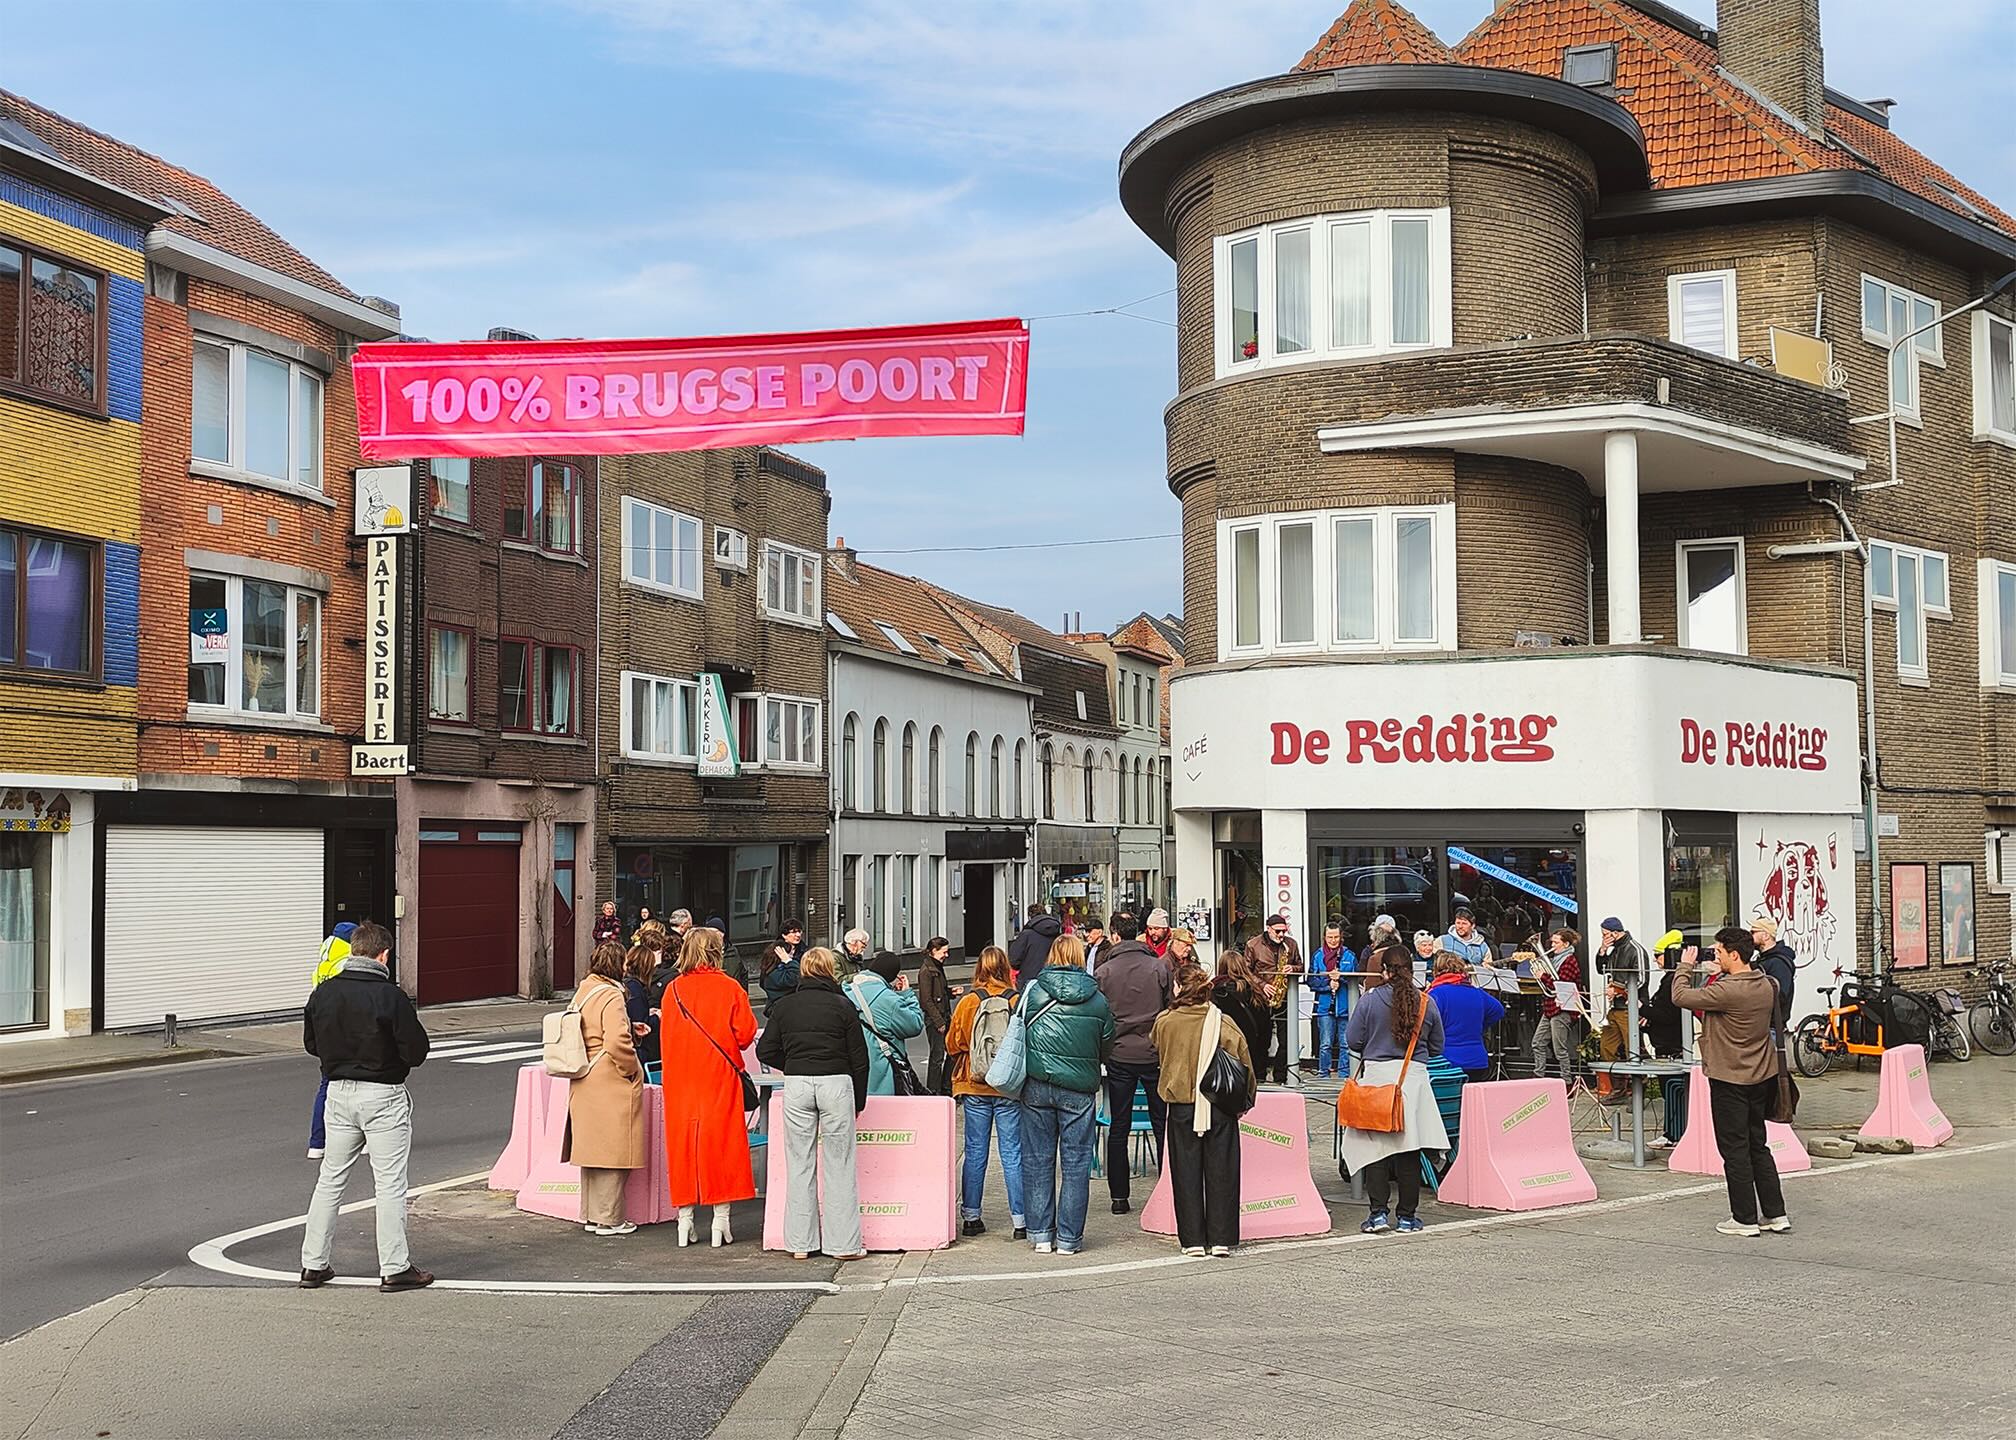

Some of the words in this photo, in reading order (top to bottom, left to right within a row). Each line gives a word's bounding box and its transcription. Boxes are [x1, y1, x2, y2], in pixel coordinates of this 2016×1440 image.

[401, 375, 551, 423] 100%
[565, 365, 787, 420] BRUGSE
[801, 355, 989, 407] POORT
[373, 540, 390, 740] PATISSERIE
[702, 676, 711, 755] BAKKERIJ
[1182, 733, 1207, 762] CAFÉ
[1270, 722, 1330, 764] De
[1345, 712, 1558, 763] Redding
[1680, 718, 1717, 765] De
[1725, 721, 1828, 771] Redding
[355, 751, 406, 768] Baert
[700, 765, 733, 774] DEHAECK
[1448, 847, 1474, 863] BRUGSE
[1474, 859, 1497, 873] POORT
[1505, 874, 1523, 887] 100%
[1523, 883, 1550, 899] BRUGSE
[1550, 894, 1575, 909] POORT
[876, 1132, 912, 1141] POORT
[1240, 1123, 1266, 1138] BRUGSE
[1267, 1133, 1291, 1145] POORT
[867, 1205, 903, 1213] POORT
[1246, 1201, 1273, 1212] BRUGSE
[1273, 1197, 1296, 1208] POORT
